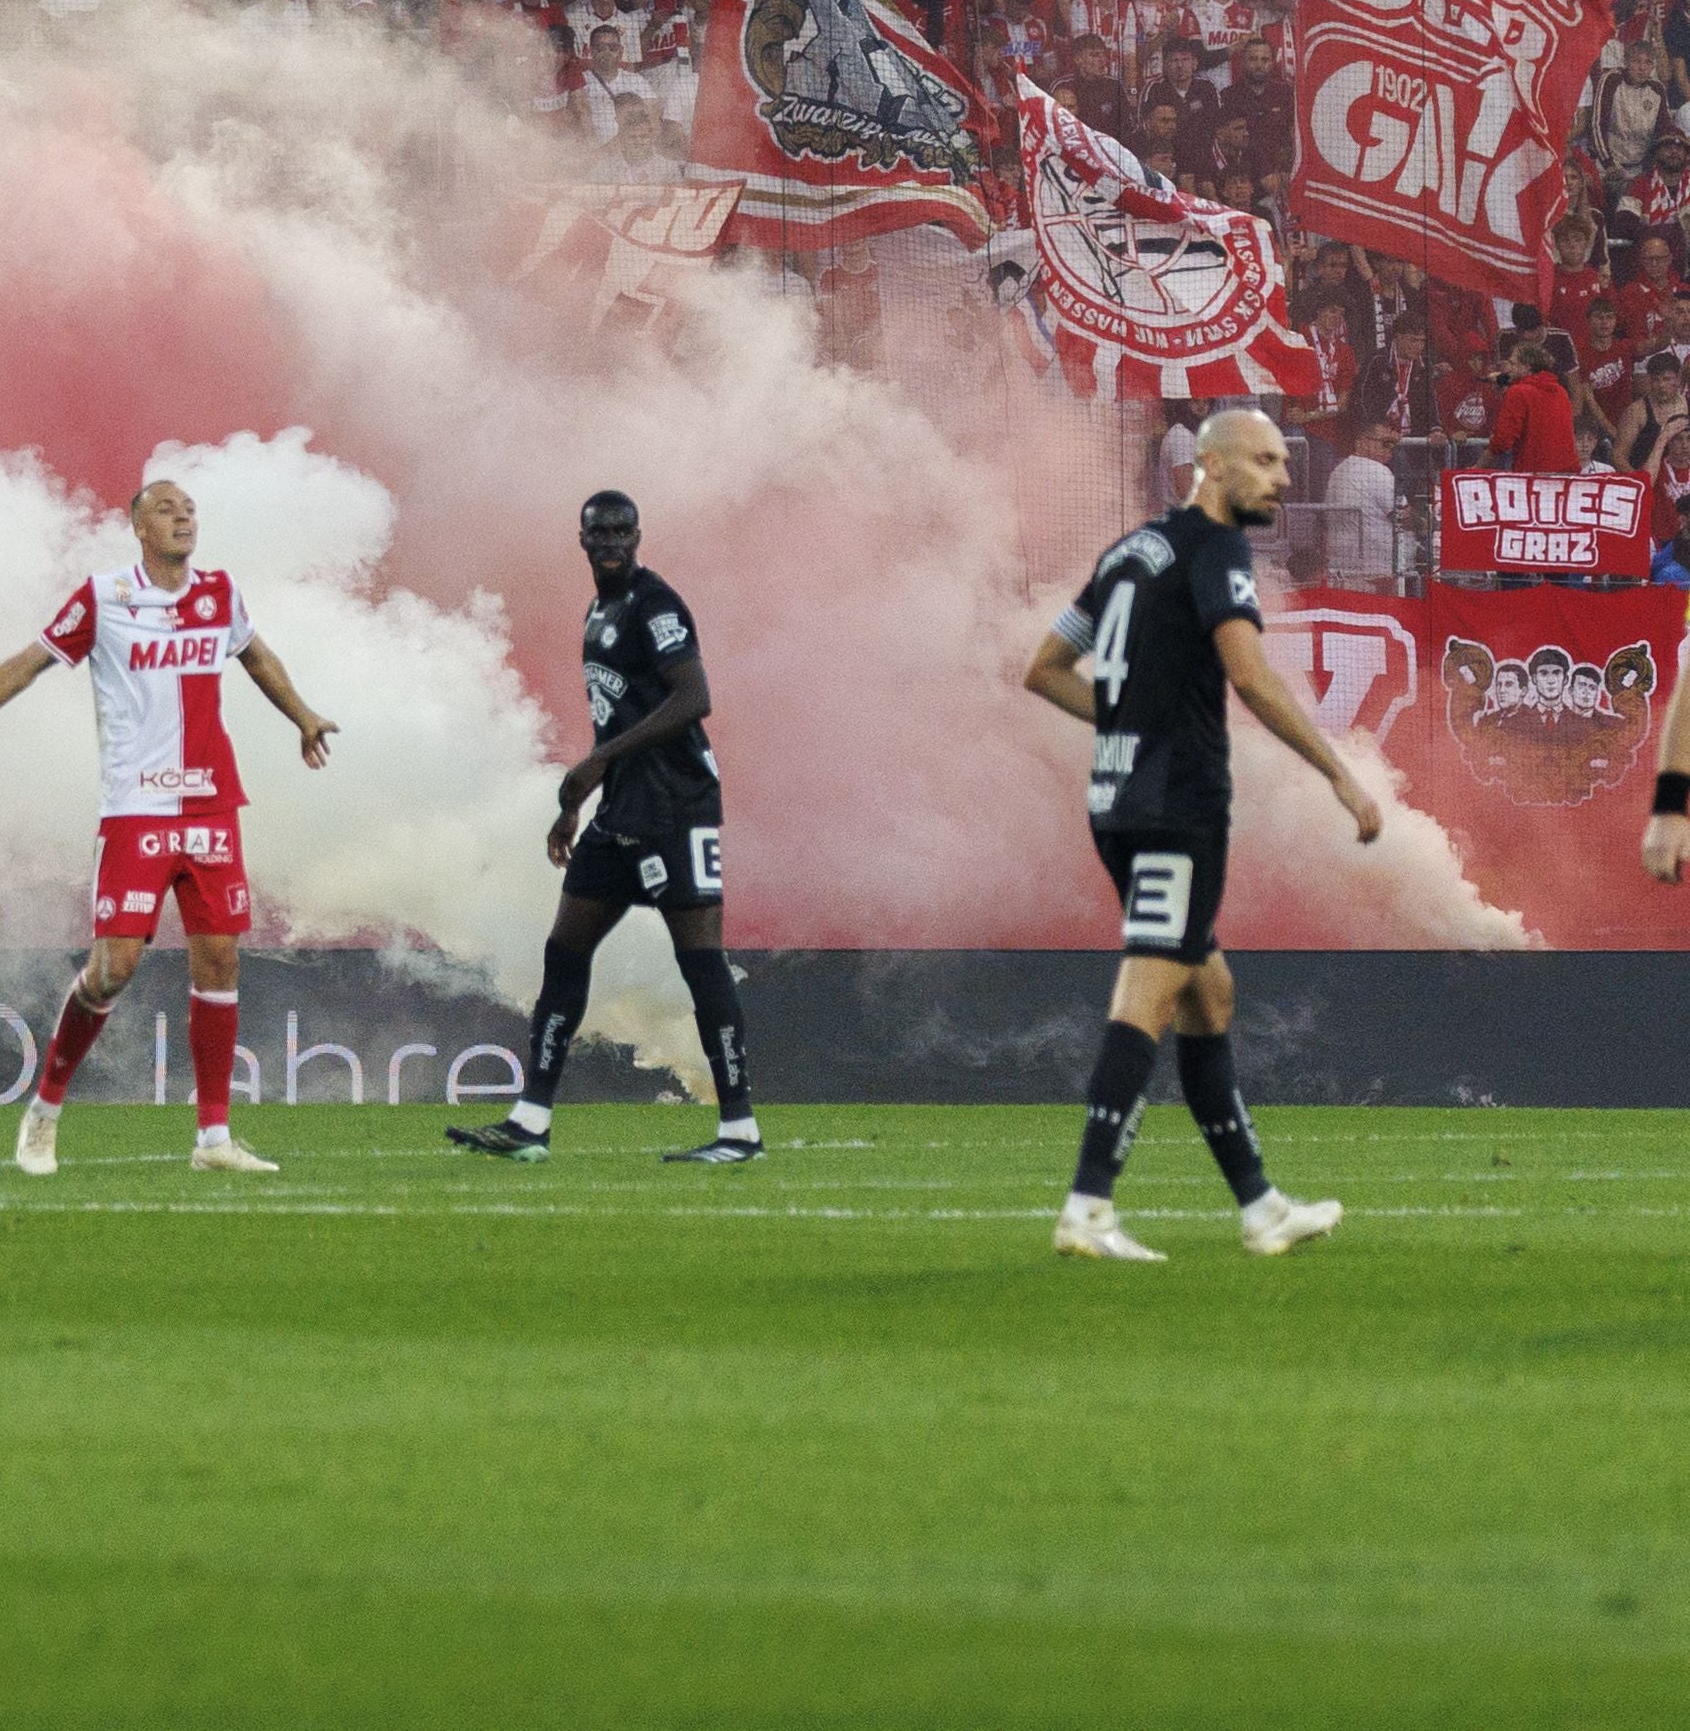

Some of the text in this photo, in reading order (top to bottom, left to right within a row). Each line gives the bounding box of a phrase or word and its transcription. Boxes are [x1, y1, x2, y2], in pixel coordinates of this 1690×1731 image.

[1376, 65, 1427, 112] 1902
[1312, 58, 1557, 251] GAK
[1456, 475, 1641, 534] ROTES
[1500, 529, 1597, 564] GRAZ
[129, 637, 219, 671] MAPEI
[1094, 580, 1136, 706] 4
[140, 767, 216, 789] KÖCK
[140, 828, 231, 856] GRAZ
